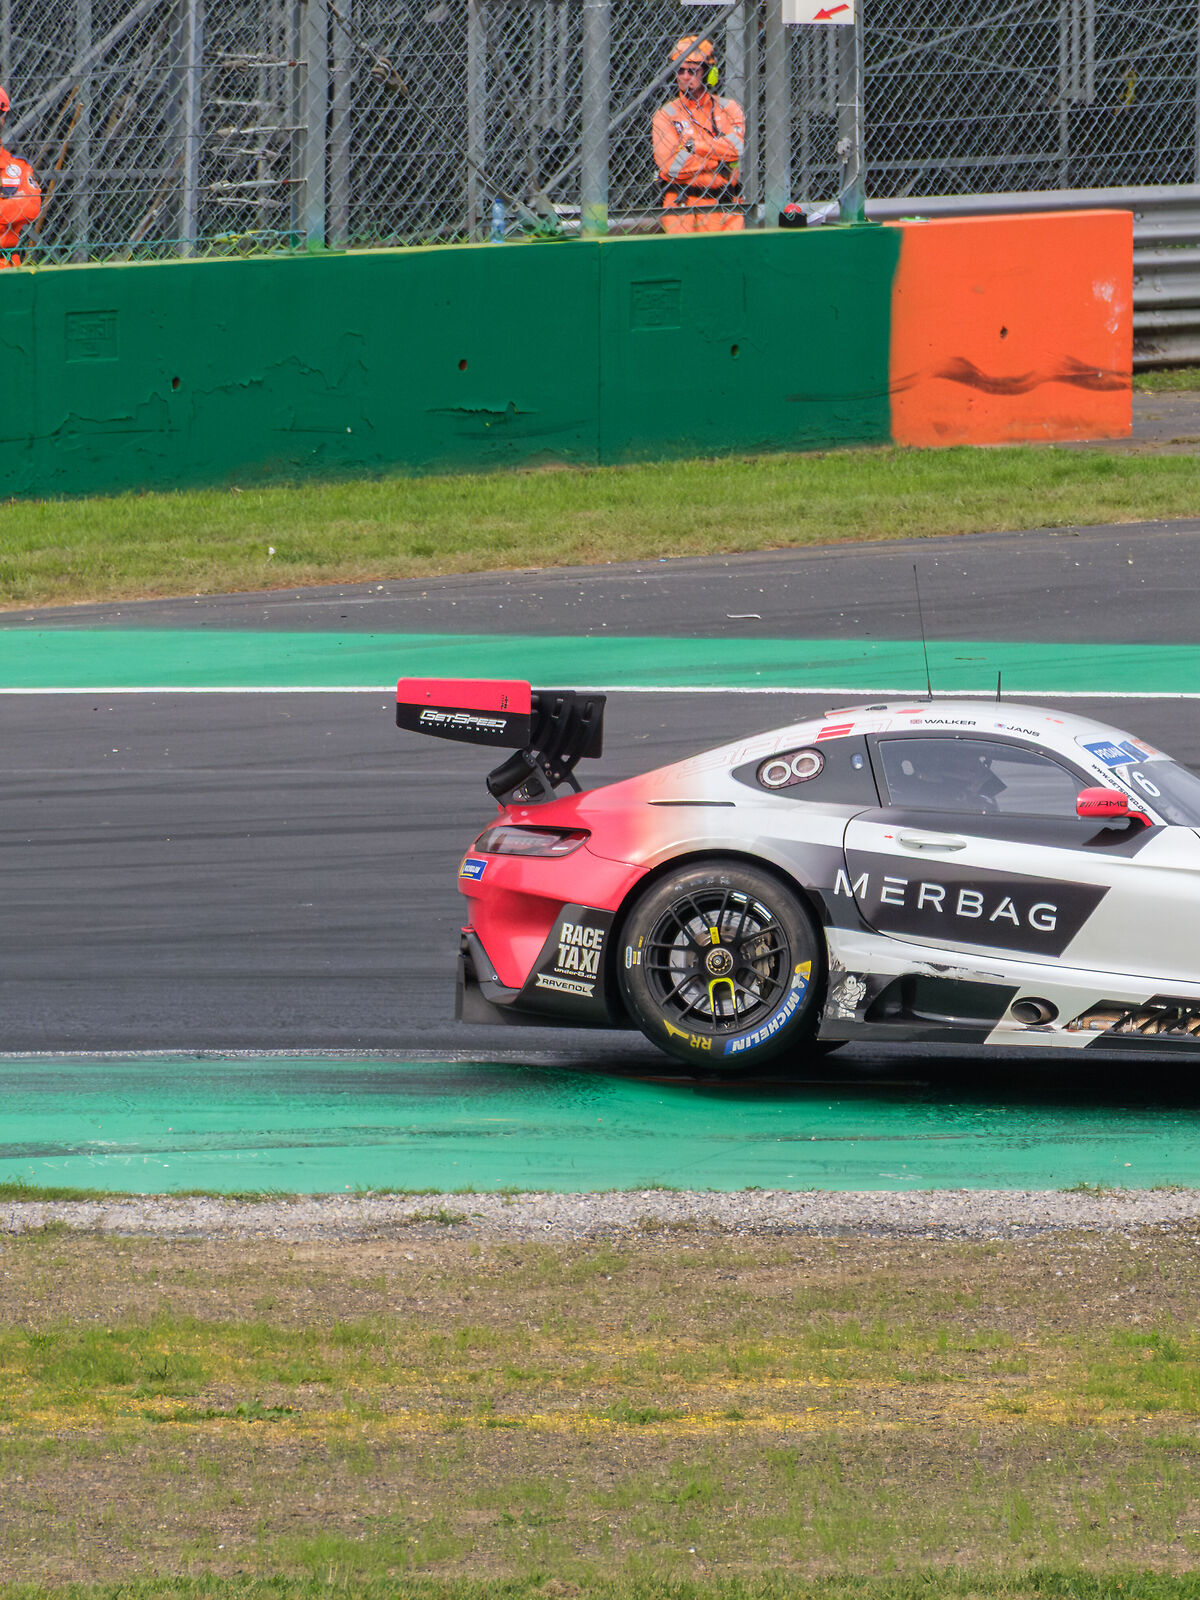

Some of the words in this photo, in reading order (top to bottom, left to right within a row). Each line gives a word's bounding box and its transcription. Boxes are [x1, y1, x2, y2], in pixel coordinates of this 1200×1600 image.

[1006, 725, 1040, 737] JANS
[1132, 771, 1161, 797] 6
[833, 869, 1058, 932] MERBAG
[560, 922, 605, 950] RACE
[558, 943, 600, 974] TAXI
[542, 978, 588, 993] RAVENOL
[732, 991, 801, 1052] MICHELIN
[690, 1036, 713, 1049] RR
